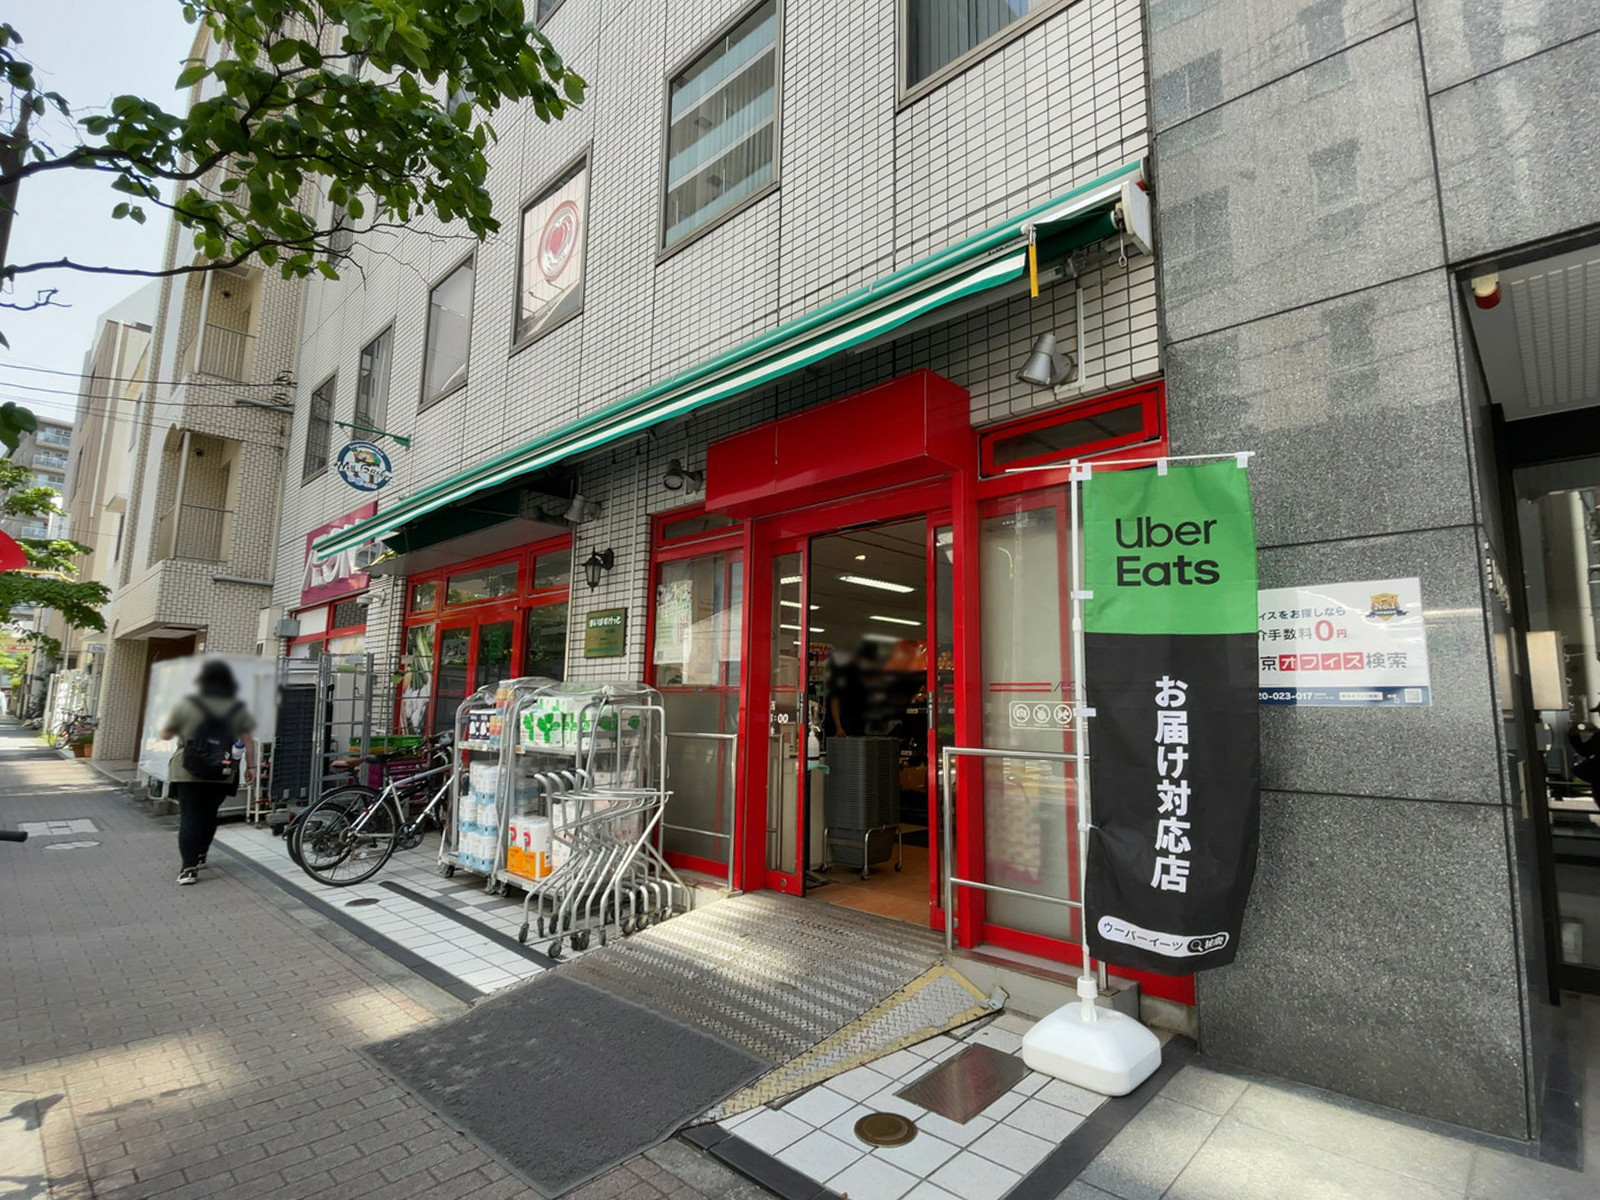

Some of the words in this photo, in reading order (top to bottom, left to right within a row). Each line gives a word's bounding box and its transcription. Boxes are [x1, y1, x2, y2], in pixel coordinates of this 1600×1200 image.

[1115, 516, 1218, 549] Uber
[1116, 555, 1220, 587] Eats
[1150, 675, 1192, 893] お届け対応店
[1104, 921, 1183, 951] ウーバーイーツ
